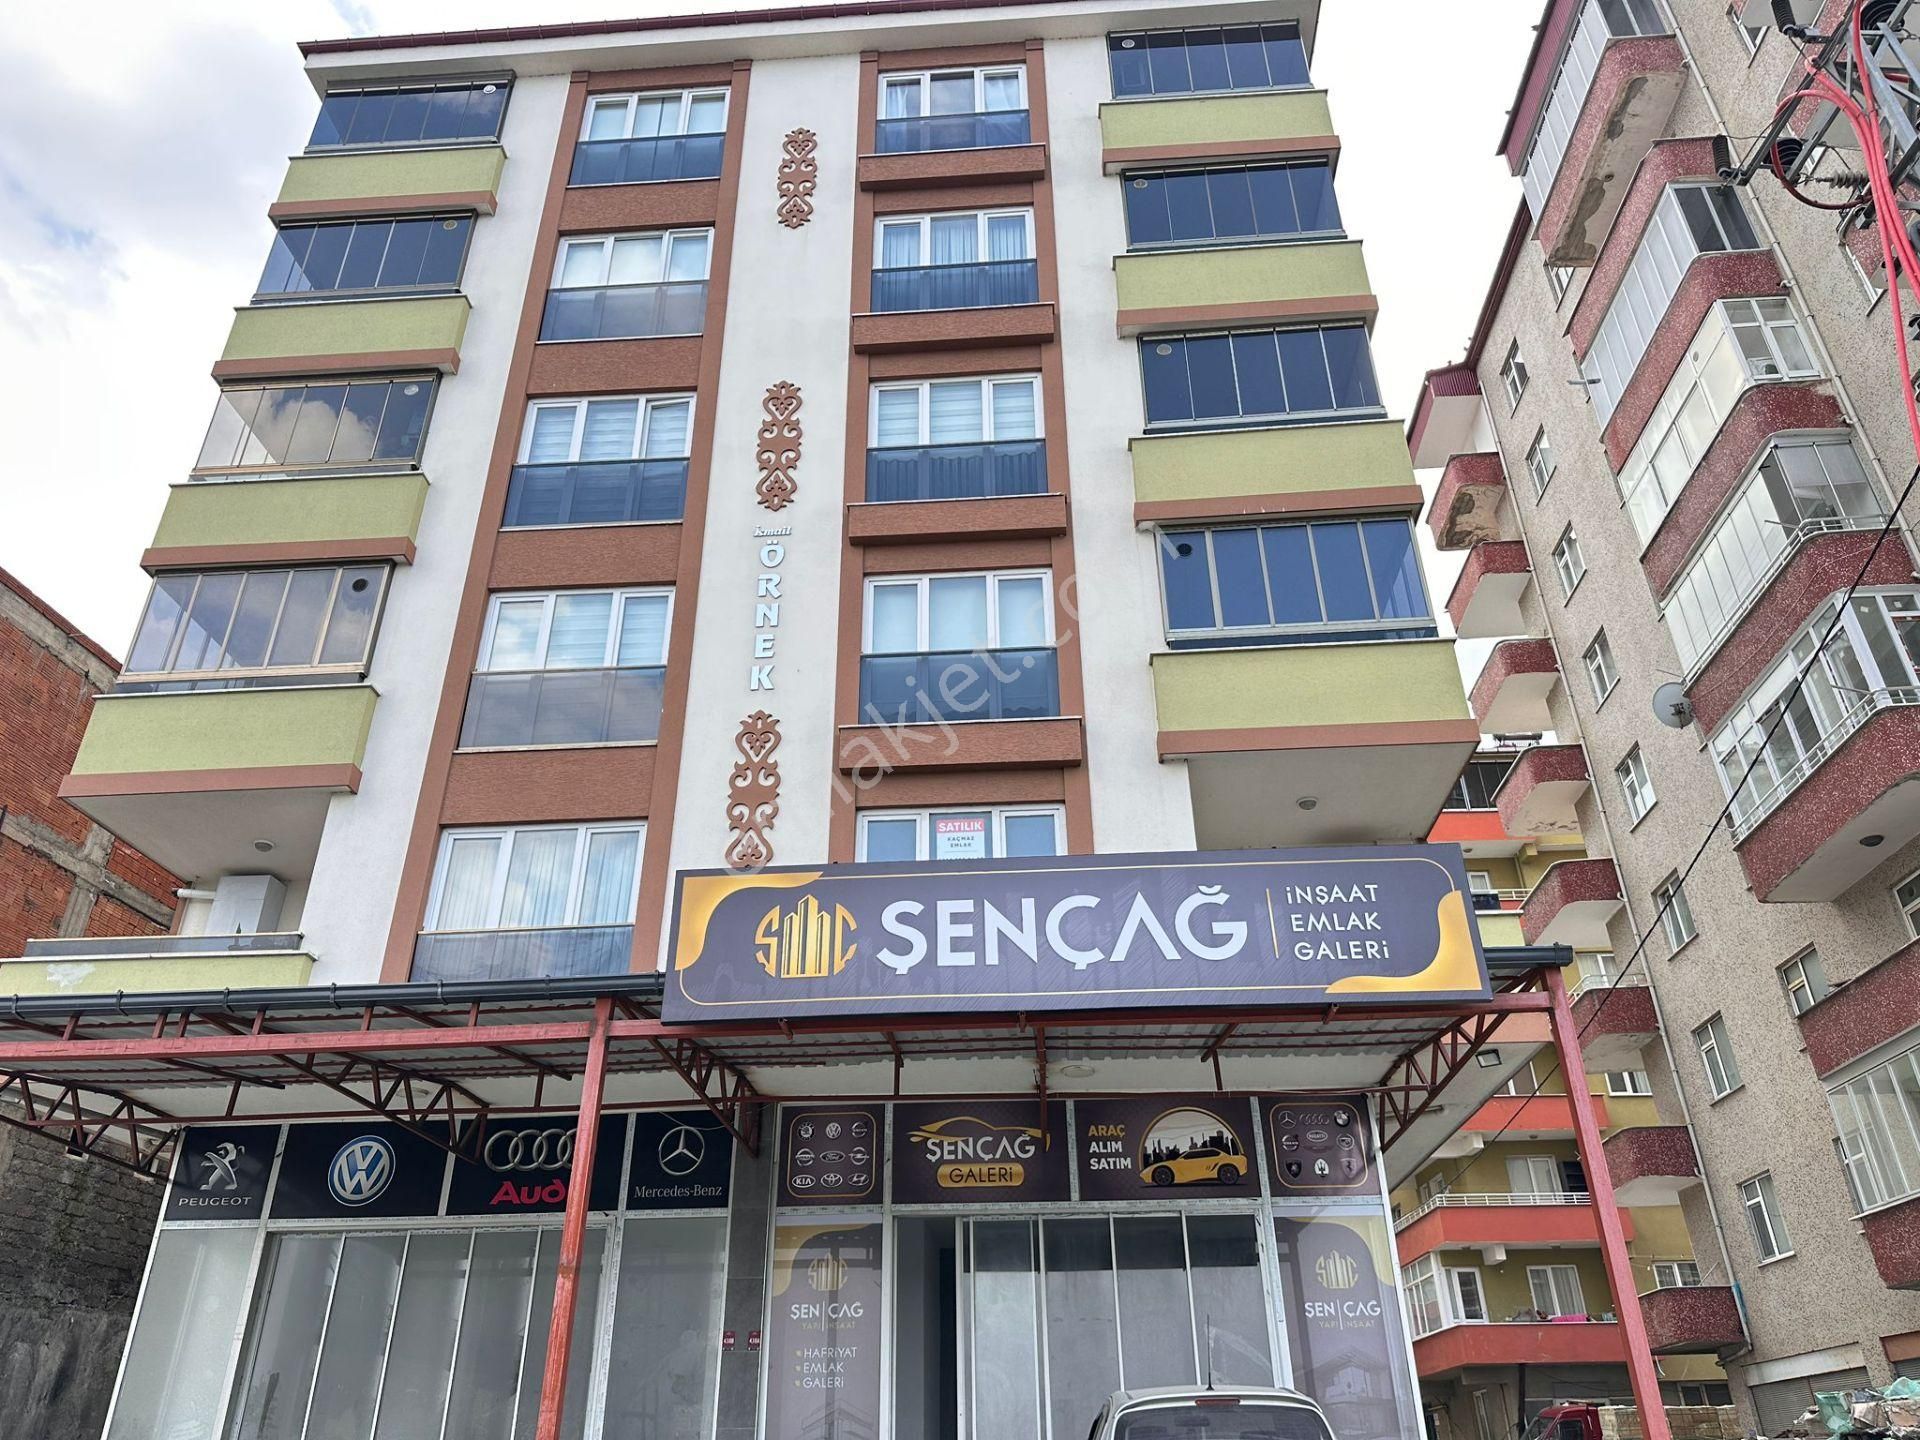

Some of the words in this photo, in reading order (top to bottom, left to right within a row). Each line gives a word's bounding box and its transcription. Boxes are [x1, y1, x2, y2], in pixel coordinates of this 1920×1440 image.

[749, 539, 785, 691] ÖRNEK
[938, 821, 983, 832] SATILIK
[1286, 884, 1378, 906] İNŞAAT
[876, 885, 1248, 975] ŞENÇAĞ
[1291, 912, 1382, 933] EMLAK
[1294, 940, 1390, 961] GALERİ
[1088, 1124, 1126, 1138] ARAÇ
[925, 1133, 1036, 1163] ŞENÇAĞ
[1089, 1141, 1123, 1153] ALIM
[1090, 1157, 1132, 1170] SATIM
[950, 1166, 1013, 1184] GALERİ
[489, 1178, 568, 1206] Aud
[634, 1184, 723, 1199] Mercedes-Benz
[178, 1196, 252, 1207] PEUGEOT
[804, 1347, 857, 1359] HAFRİYAT
[803, 1361, 845, 1374] EMLAK
[802, 1376, 844, 1389] GALERİ
